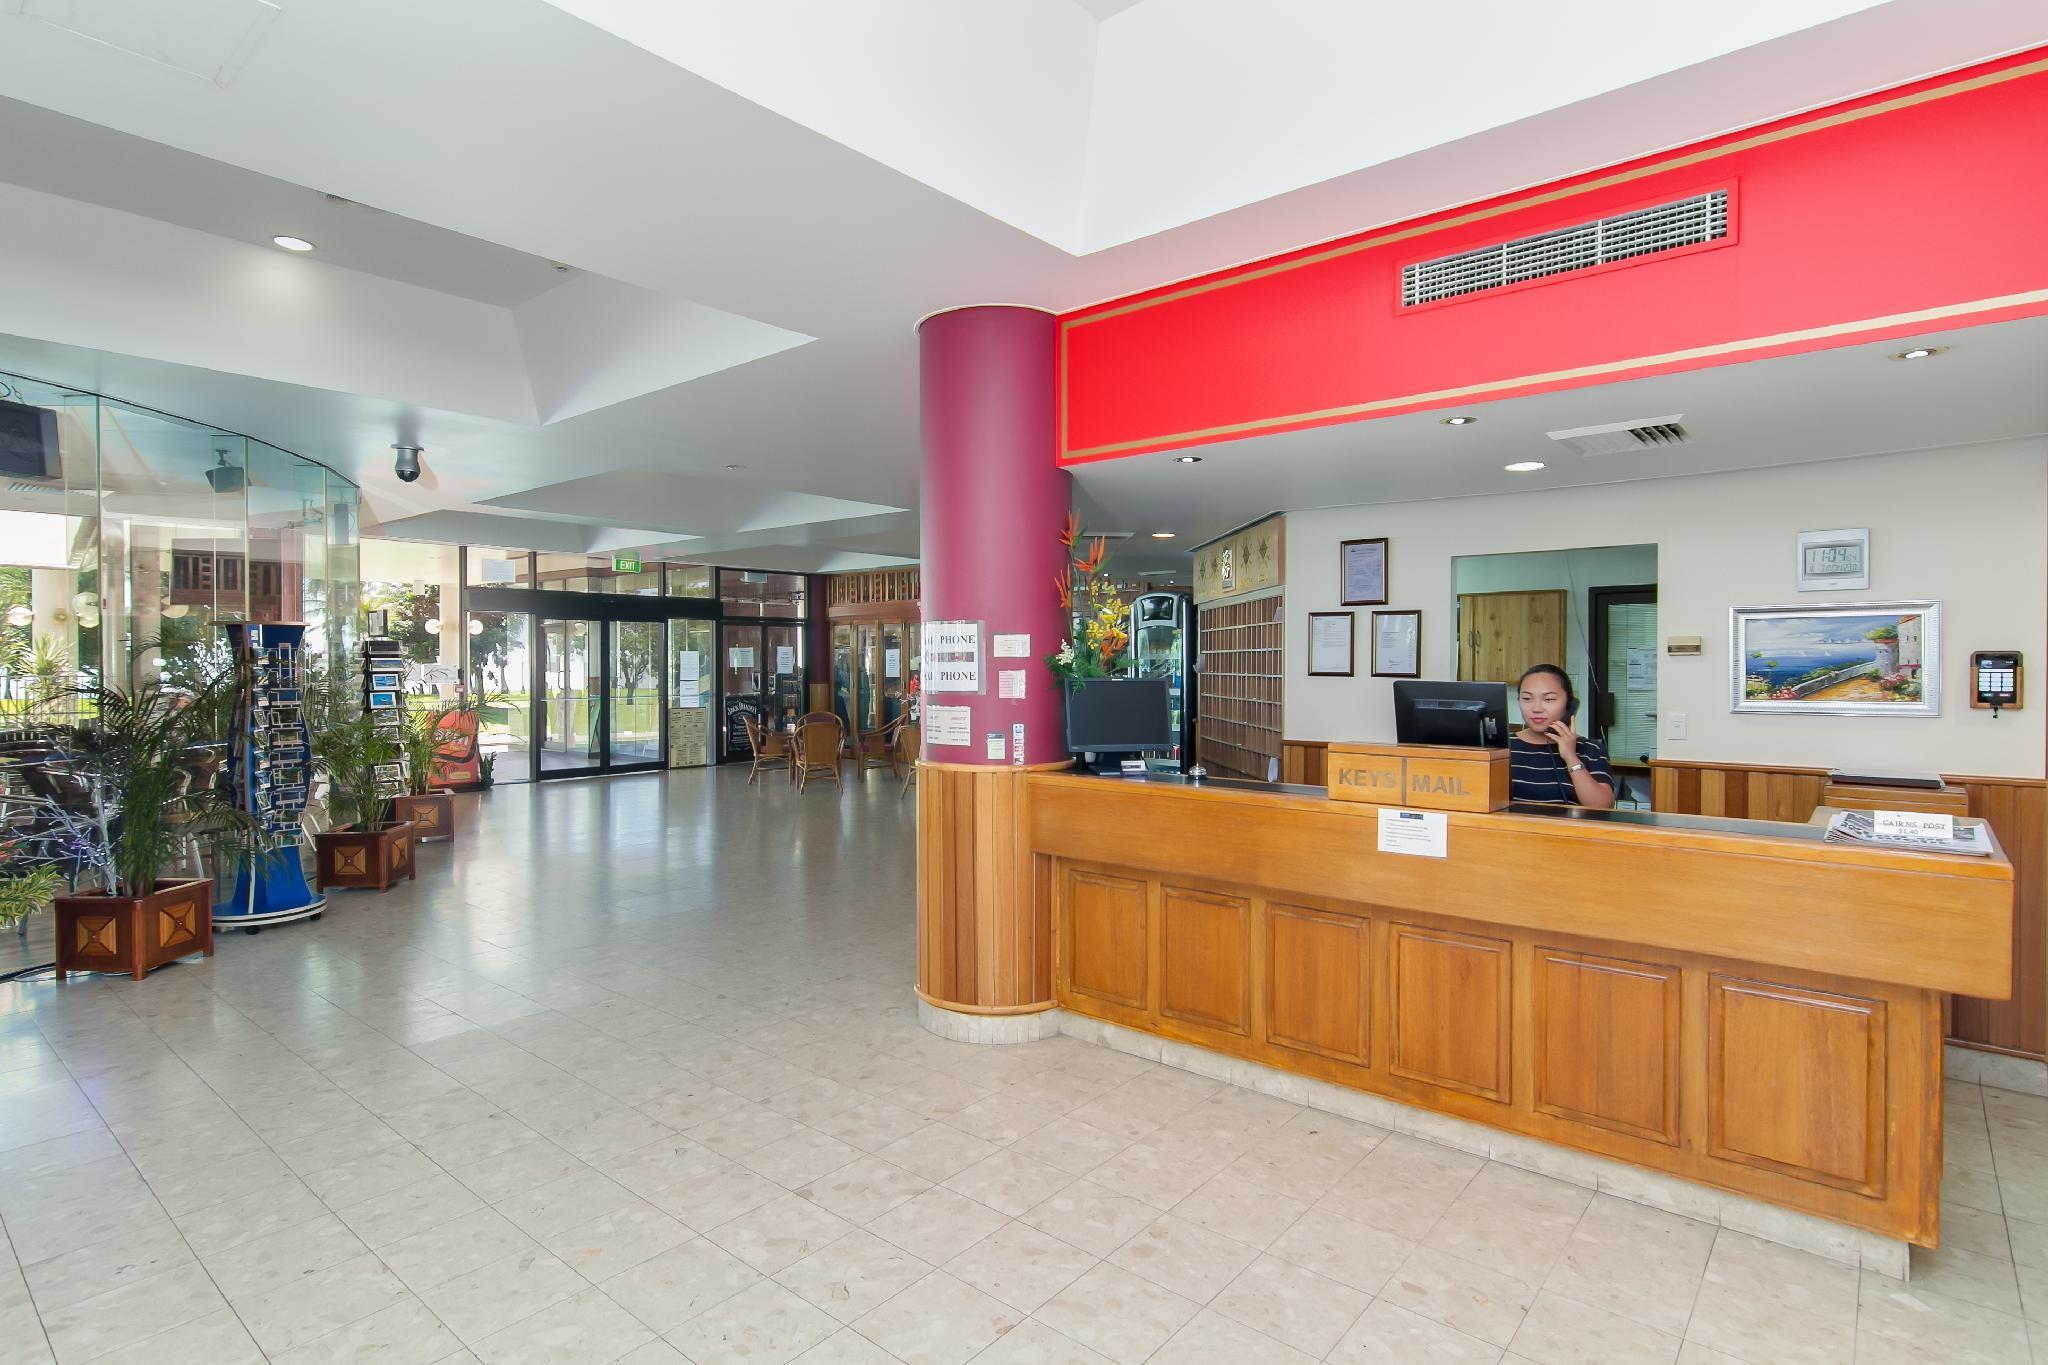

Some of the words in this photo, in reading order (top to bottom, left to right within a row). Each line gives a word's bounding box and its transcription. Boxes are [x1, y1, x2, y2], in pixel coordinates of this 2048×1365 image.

[1812, 548, 1847, 562] 11:04
[620, 560, 635, 571] EXIT
[940, 635, 976, 645] PHONE
[940, 671, 977, 681] PHONE
[1338, 767, 1397, 789] KEYS
[1412, 774, 1471, 796] MAIL
[1882, 819, 1918, 829] CAIRNS
[1923, 822, 1946, 830] POST
